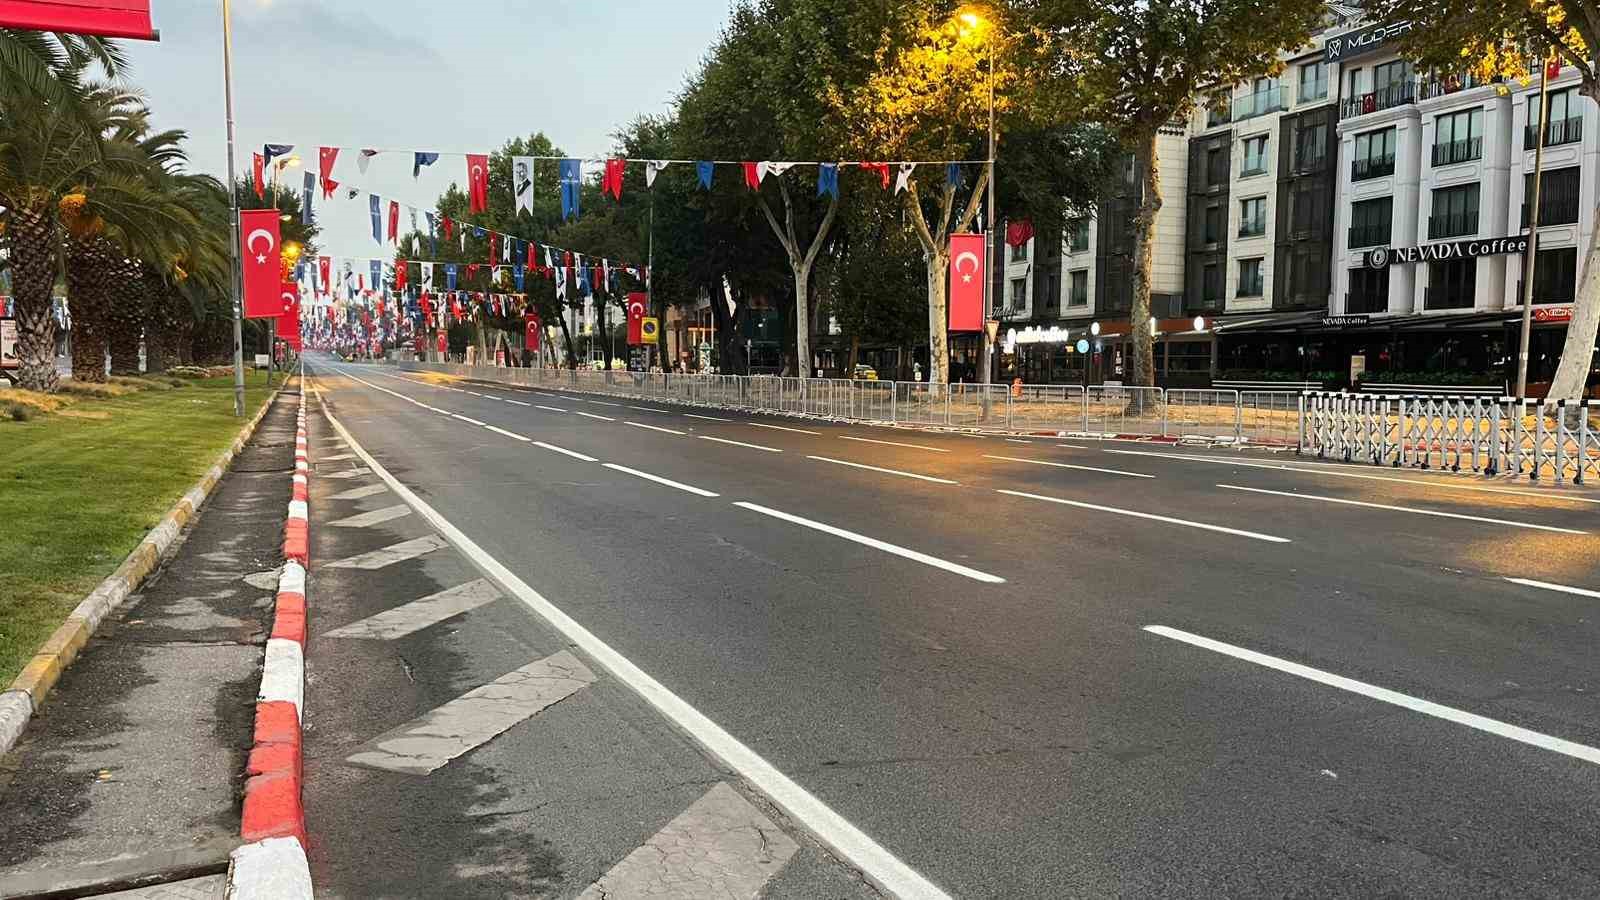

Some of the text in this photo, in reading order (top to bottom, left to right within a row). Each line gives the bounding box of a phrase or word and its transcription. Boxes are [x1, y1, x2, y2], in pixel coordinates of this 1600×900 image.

[1348, 19, 1413, 49] MODER
[1395, 239, 1527, 263] NEVADA Coffee
